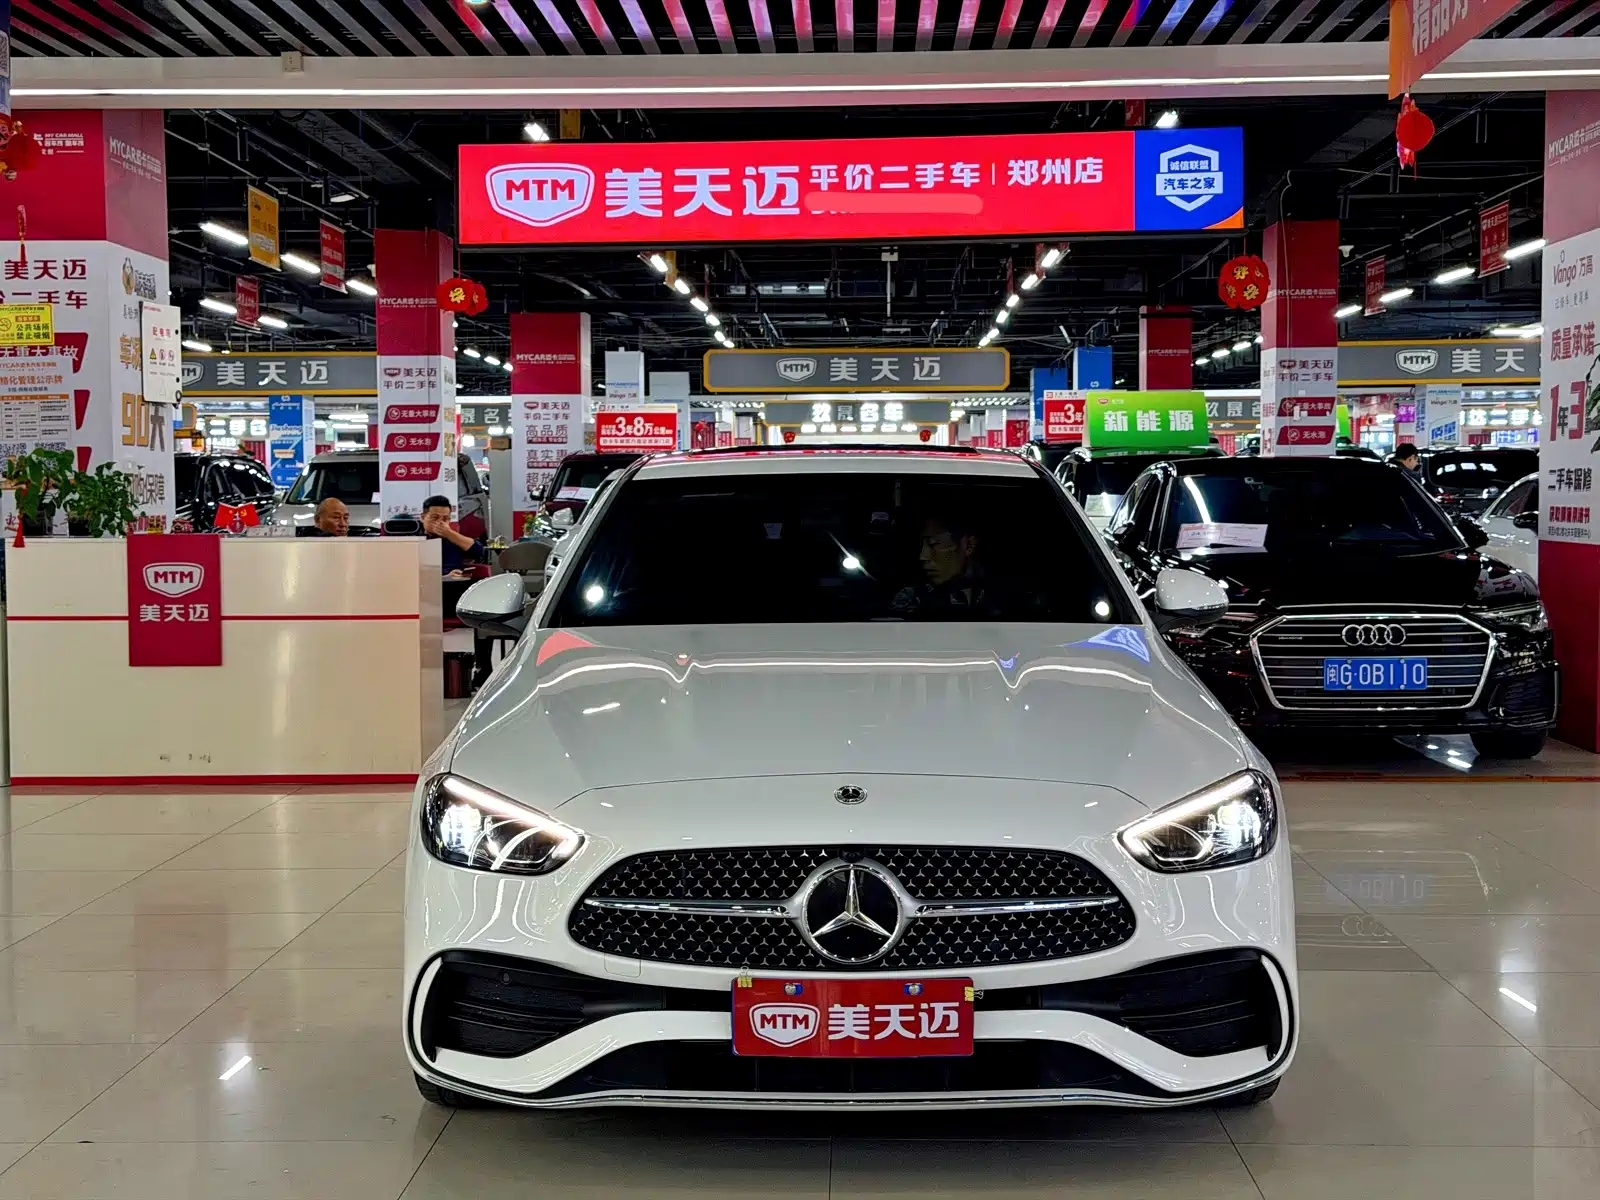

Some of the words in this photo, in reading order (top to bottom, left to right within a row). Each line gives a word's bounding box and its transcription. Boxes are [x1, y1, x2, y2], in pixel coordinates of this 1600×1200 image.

[1169, 160, 1209, 172] 诚信联盟
[505, 179, 576, 201] MTM
[604, 166, 800, 218] 美天迈
[809, 162, 981, 190] 平价二手车
[1007, 157, 1104, 187] 郑州店
[1163, 176, 1216, 191] 汽车之家
[4, 259, 87, 280] 美天迈
[1579, 254, 1593, 276] 万高
[16, 323, 50, 331] 公共场所
[1551, 322, 1595, 361] 质量承诺
[784, 363, 810, 373] MTM
[829, 357, 941, 382] 美天迈
[1299, 360, 1334, 369] 美天迈
[1403, 355, 1432, 366] MTM
[1451, 348, 1541, 374] 美天
[181, 366, 197, 377] TM
[217, 361, 328, 386] 美天迈
[404, 367, 437, 377] 美天迈
[383, 380, 437, 390] 平价二手车
[526, 424, 568, 438] 高品质
[1103, 409, 1195, 432] 新能源
[1548, 467, 1592, 492] 二手车保修
[153, 570, 194, 584] MTM
[139, 604, 210, 622] 美天迈
[760, 1013, 810, 1030] MTM
[828, 1002, 960, 1041] 美天迈
